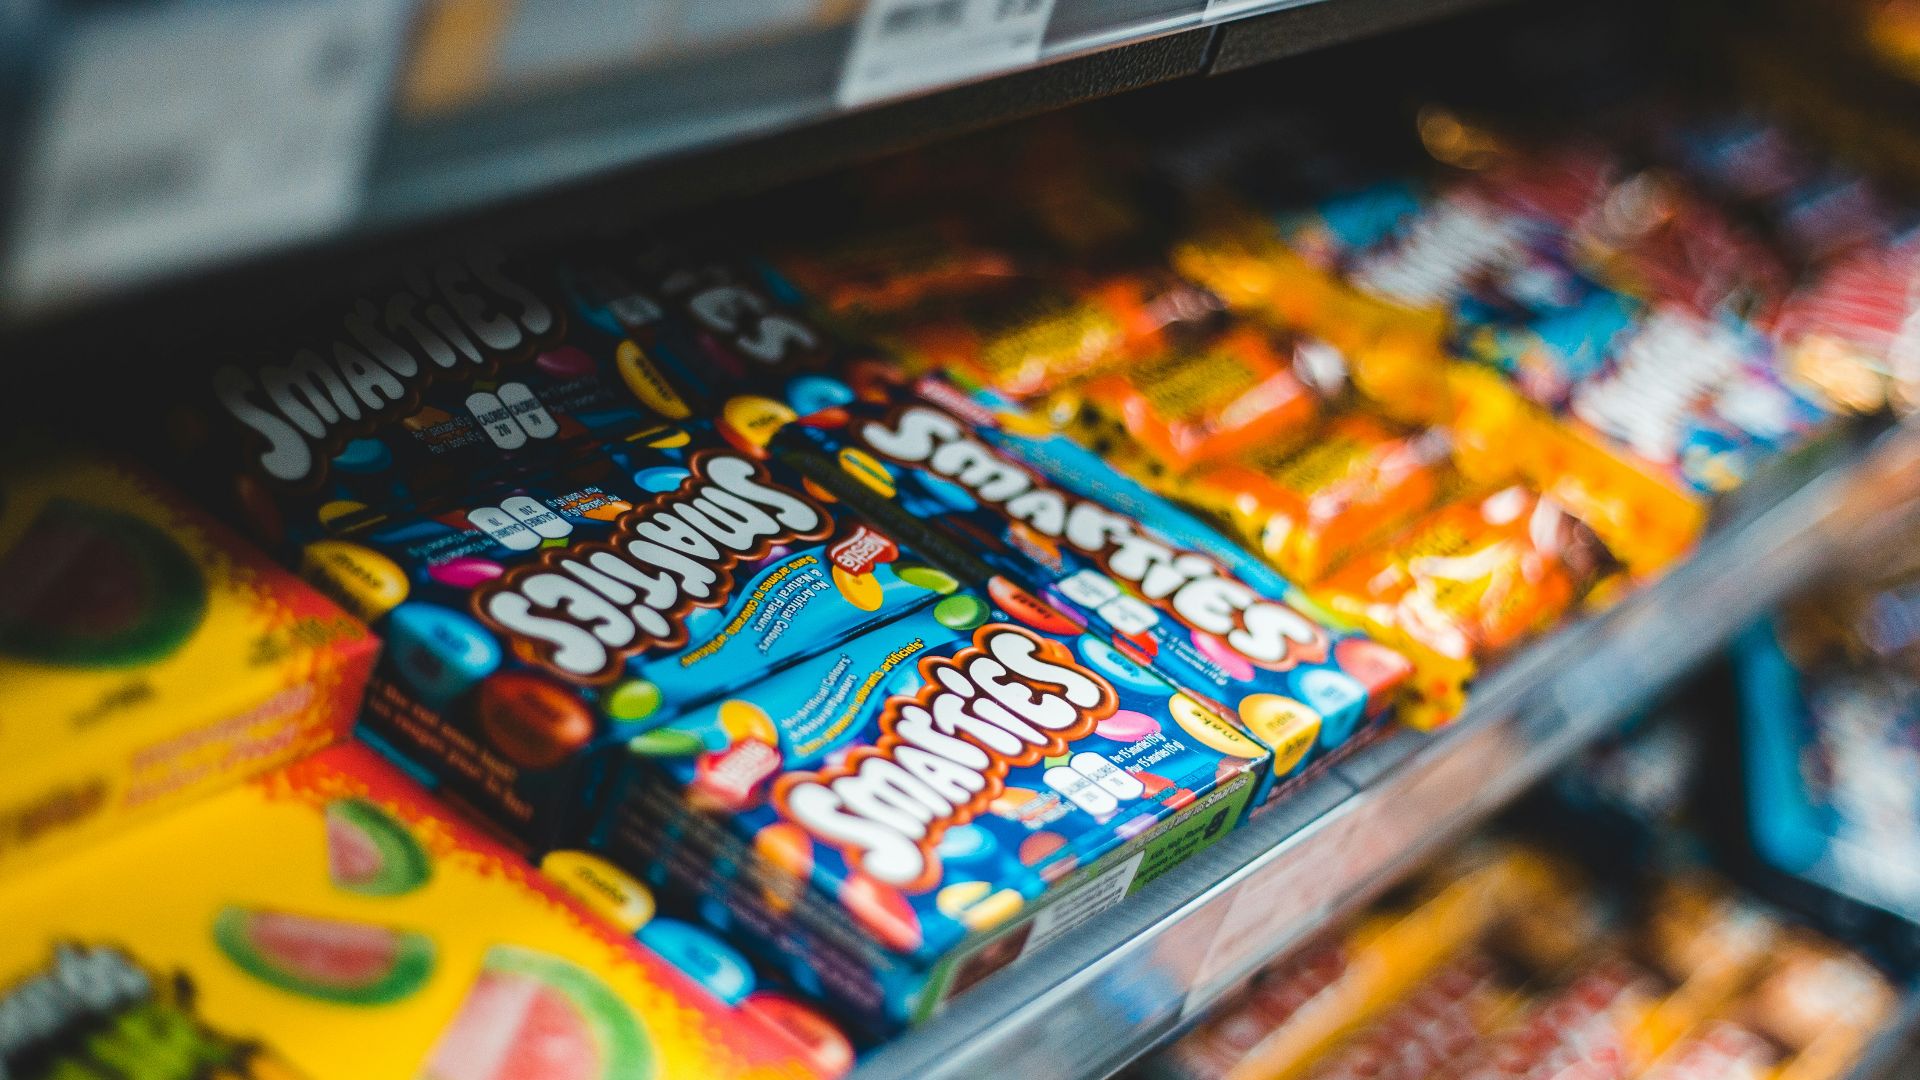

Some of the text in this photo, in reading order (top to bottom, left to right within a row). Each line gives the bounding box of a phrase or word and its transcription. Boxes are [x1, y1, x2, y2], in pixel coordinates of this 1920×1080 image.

[518, 505, 536, 516] 210
[527, 512, 559, 529] CALORIES
[490, 523, 527, 540] CALORIES
[788, 555, 818, 571] Sans
[759, 565, 791, 593] arômes
[811, 579, 831, 592] No
[753, 567, 823, 633] & Natural Flavours
[780, 587, 817, 622] Artificial
[1190, 710, 1240, 743] make
[1124, 738, 1152, 756] Smarties
[1143, 748, 1171, 765] Smarties
